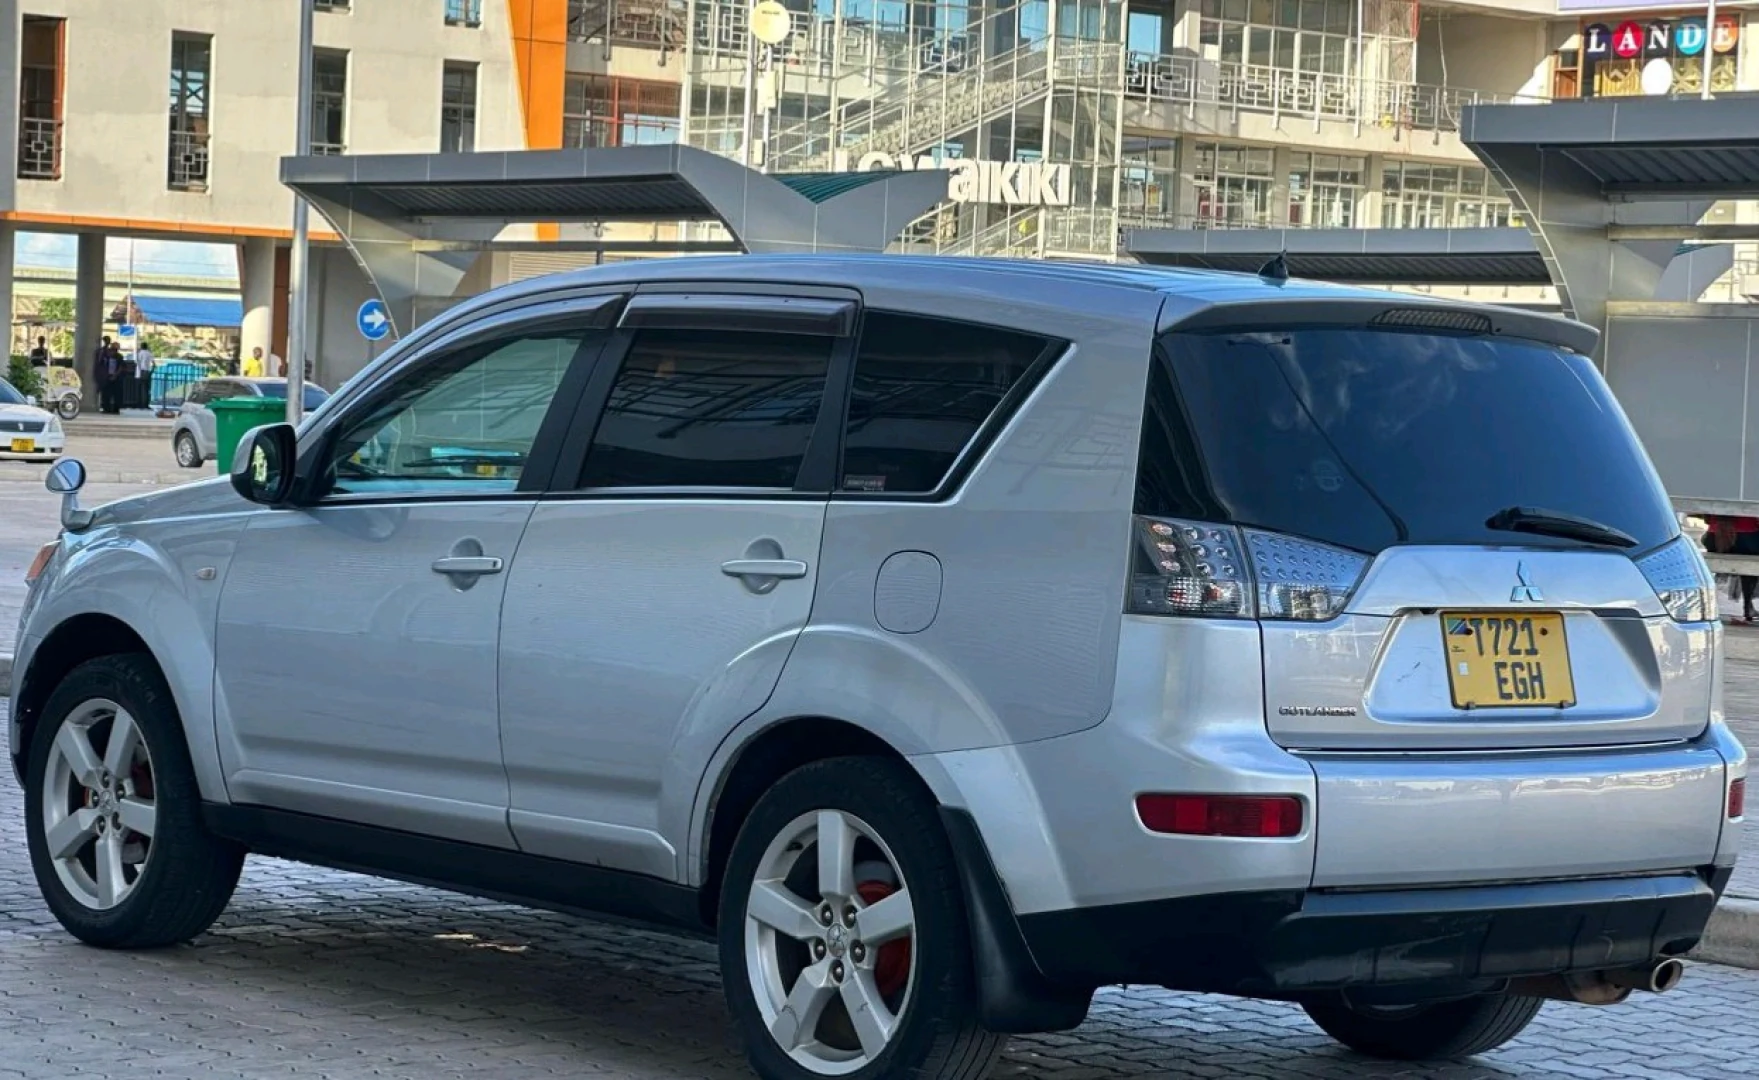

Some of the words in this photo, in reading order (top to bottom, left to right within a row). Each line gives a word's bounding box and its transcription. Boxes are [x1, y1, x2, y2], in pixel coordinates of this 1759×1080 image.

[1468, 618, 1538, 656] T721
[1494, 662, 1545, 700] EGH
[1278, 706, 1357, 716] OUTLANDER
